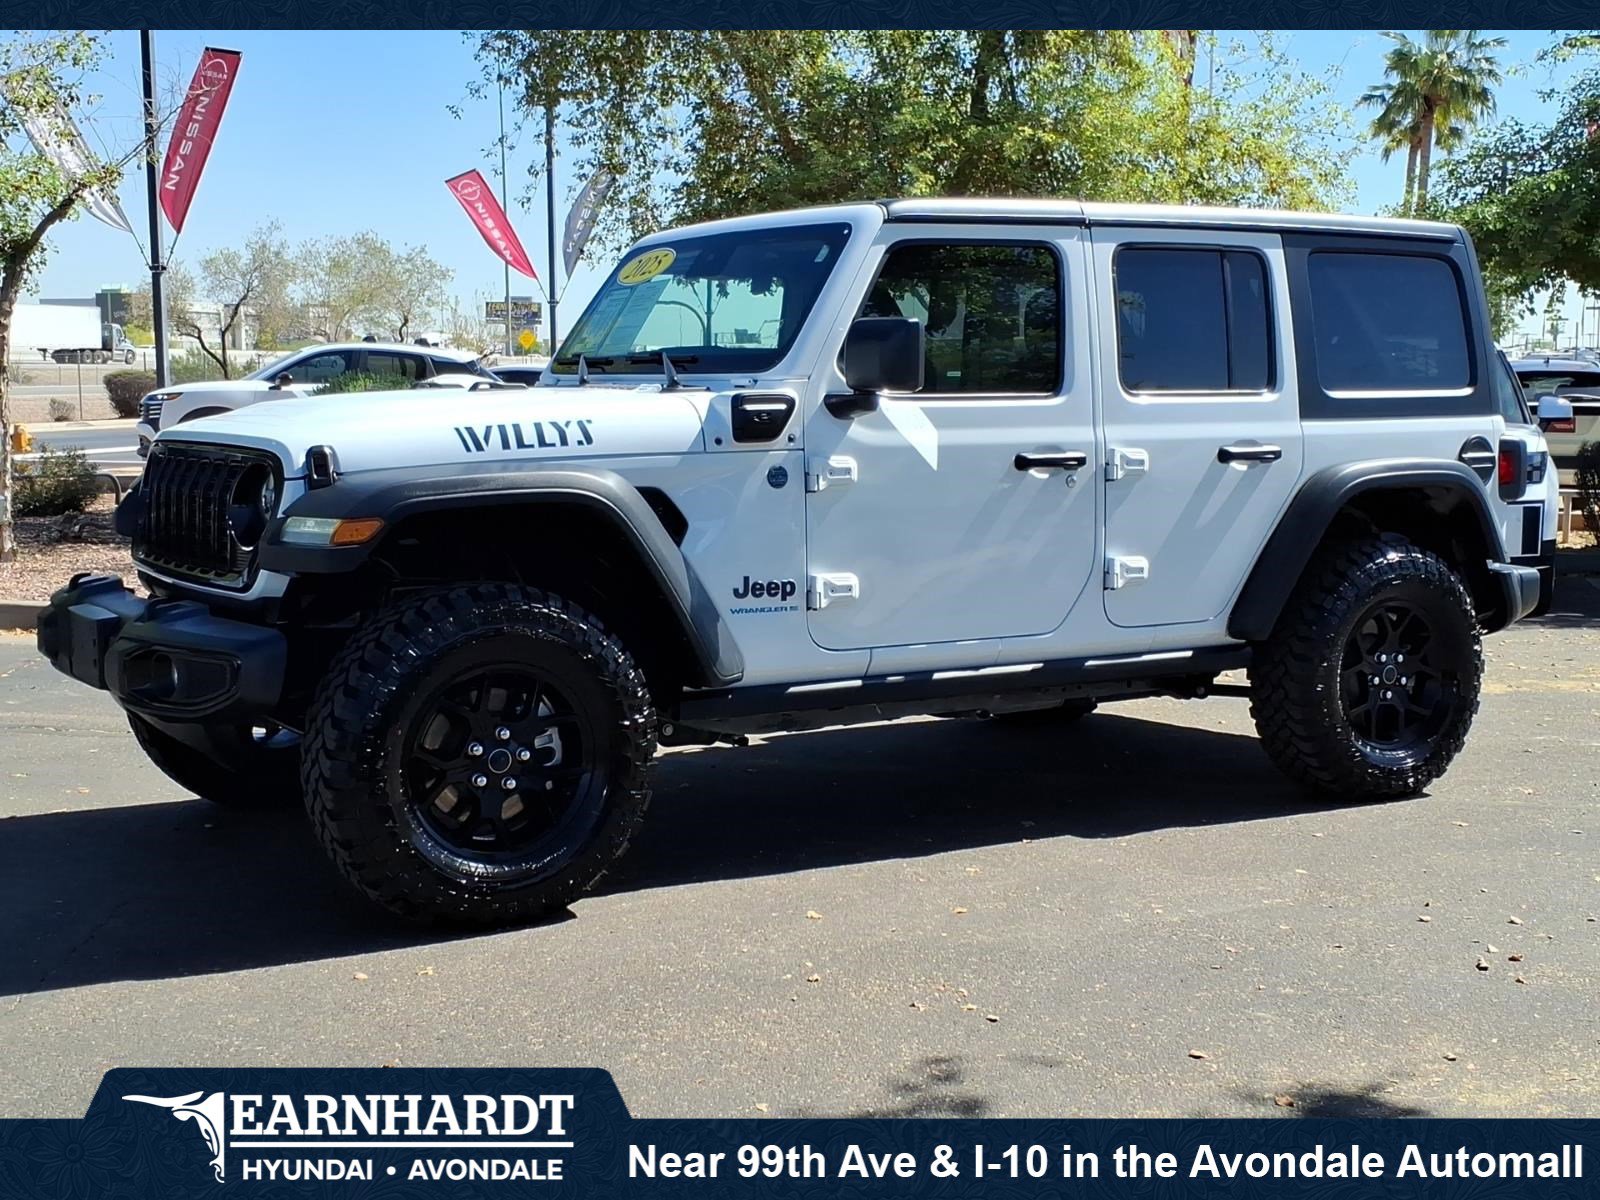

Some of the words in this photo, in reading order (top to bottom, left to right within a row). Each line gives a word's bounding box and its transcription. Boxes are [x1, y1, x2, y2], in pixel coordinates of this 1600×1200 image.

[164, 96, 210, 190] NISSAN
[474, 202, 513, 261] NISSAN
[623, 252, 670, 280] 2025
[453, 419, 594, 453] WILLYS
[732, 575, 797, 602] Jeep
[729, 606, 788, 615] WRANGLER
